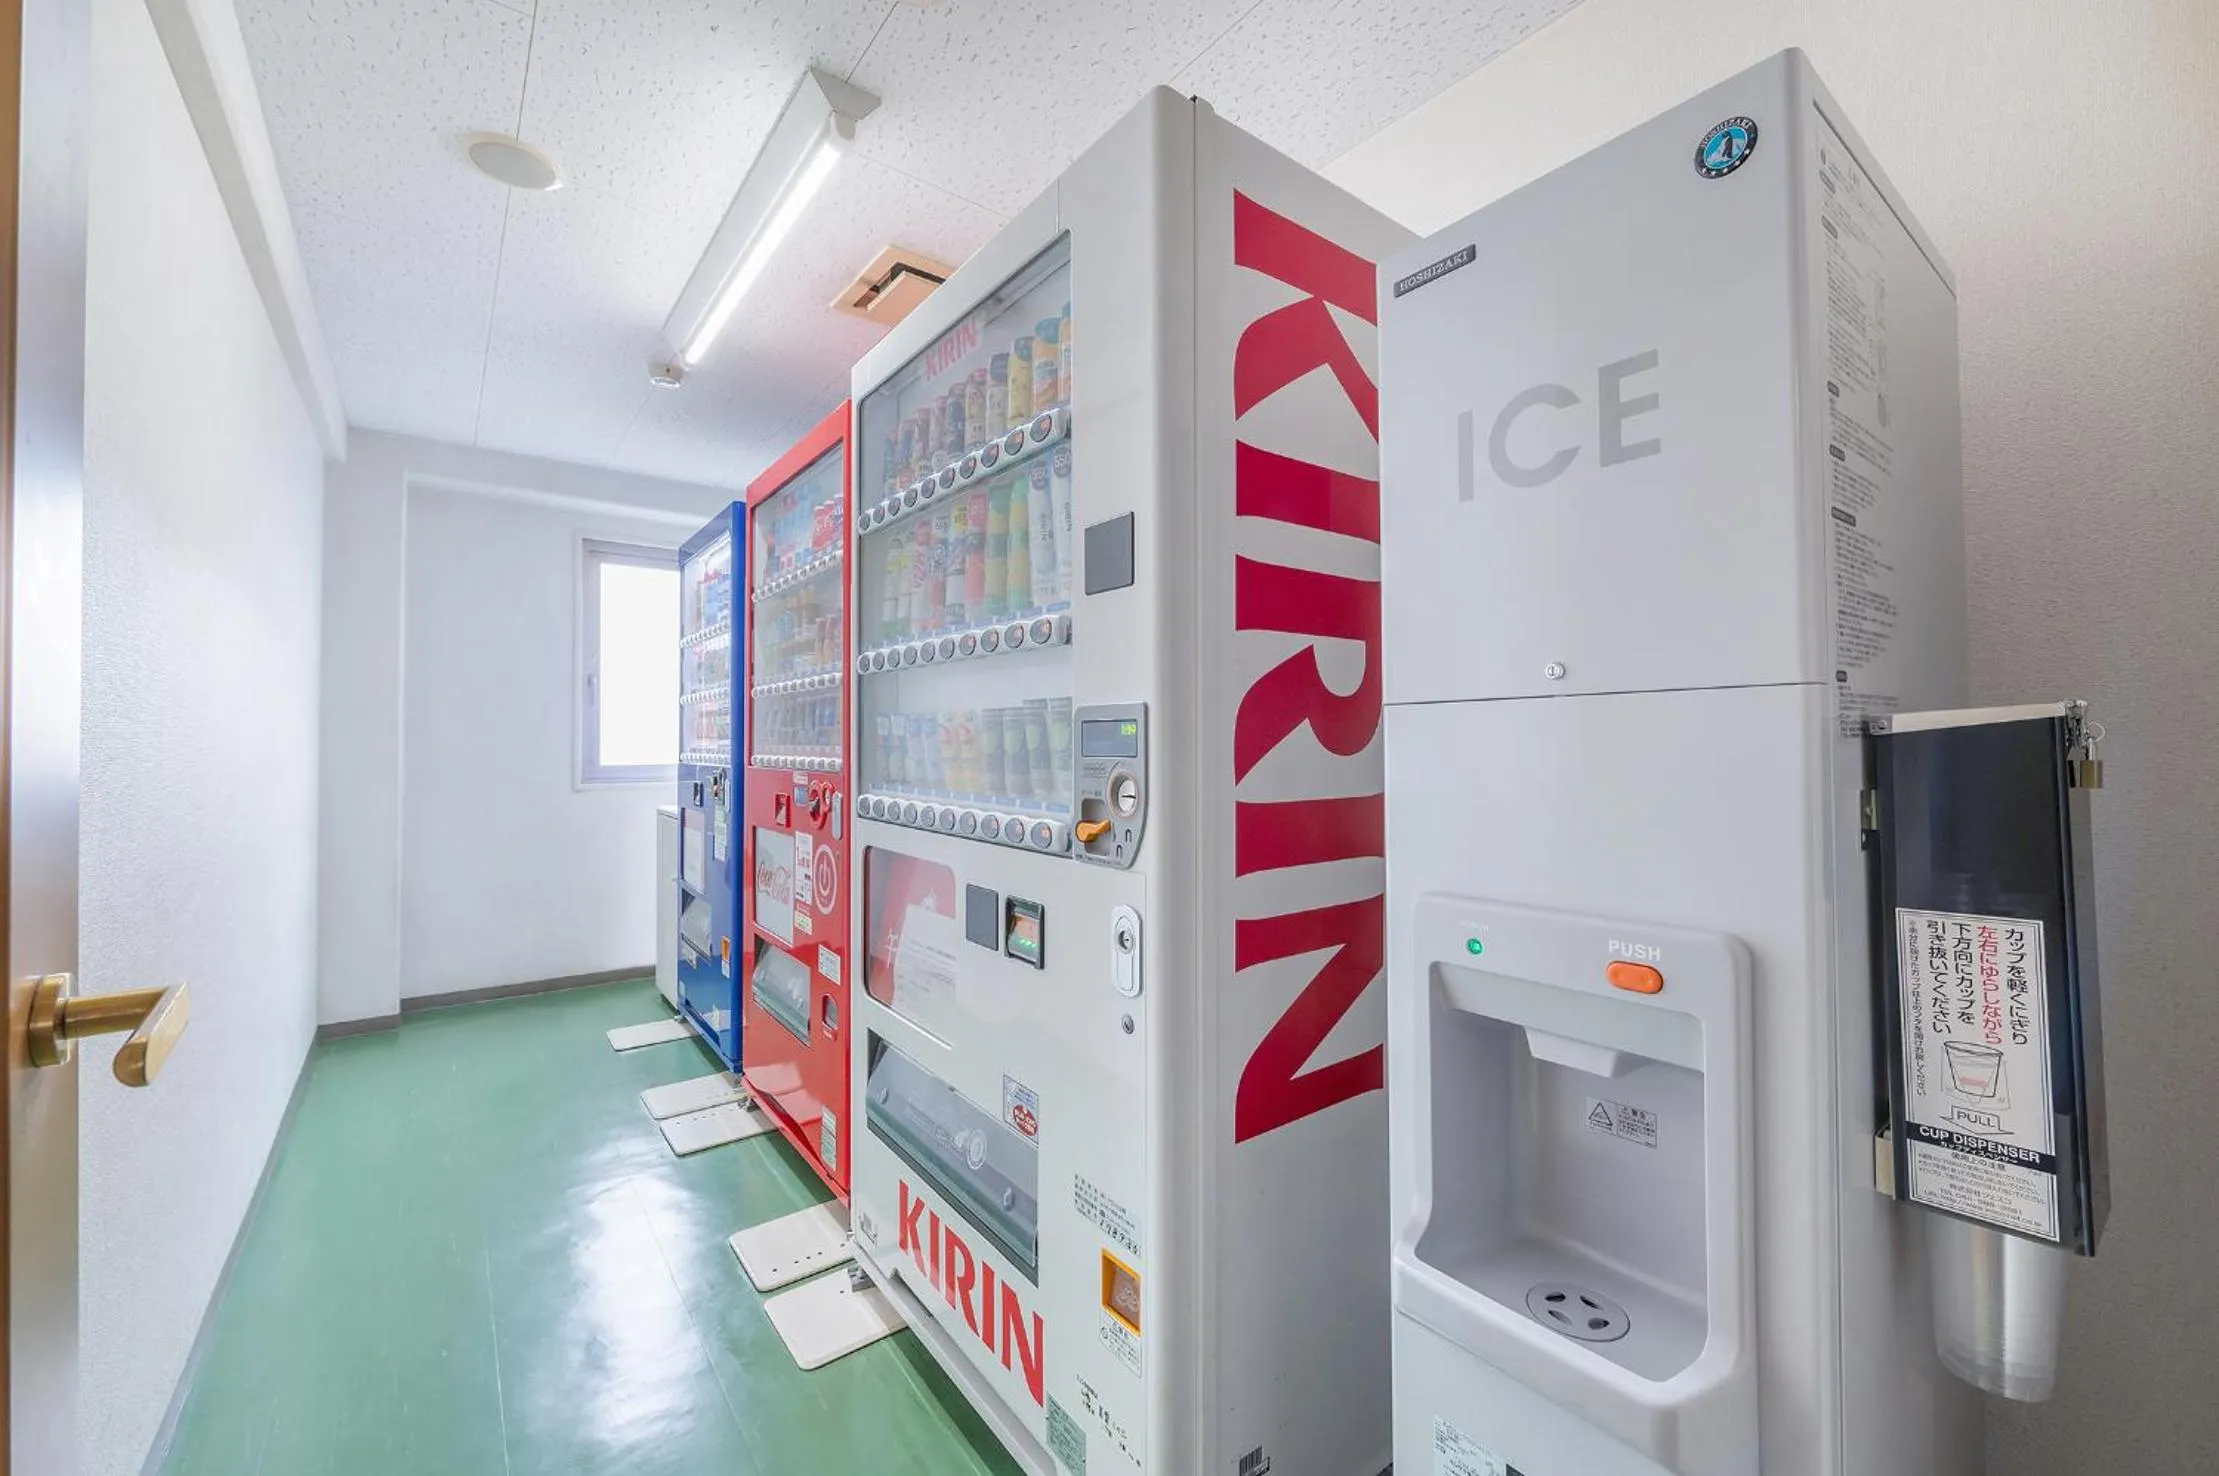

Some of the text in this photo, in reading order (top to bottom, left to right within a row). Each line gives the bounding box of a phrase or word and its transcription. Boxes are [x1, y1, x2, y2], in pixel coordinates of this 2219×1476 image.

[1400, 250, 1468, 292] HOSHIZAKI
[926, 321, 979, 381] KIRIN
[1457, 348, 1661, 504] ICE
[1235, 188, 1384, 1144] KIRIN
[1608, 939, 1662, 962] PUSH
[1927, 919, 1951, 1034] 引き抜いてください
[1952, 922, 1976, 1025] 下方向にカップを
[1977, 925, 2003, 1045] 左右にゆらしながら
[2004, 928, 2030, 1045] カップを軽くにぎり
[1919, 1126, 2041, 1164] CUP DISPENSER
[1956, 1111, 1997, 1128] PULL
[898, 1179, 1044, 1408] KIRIN
